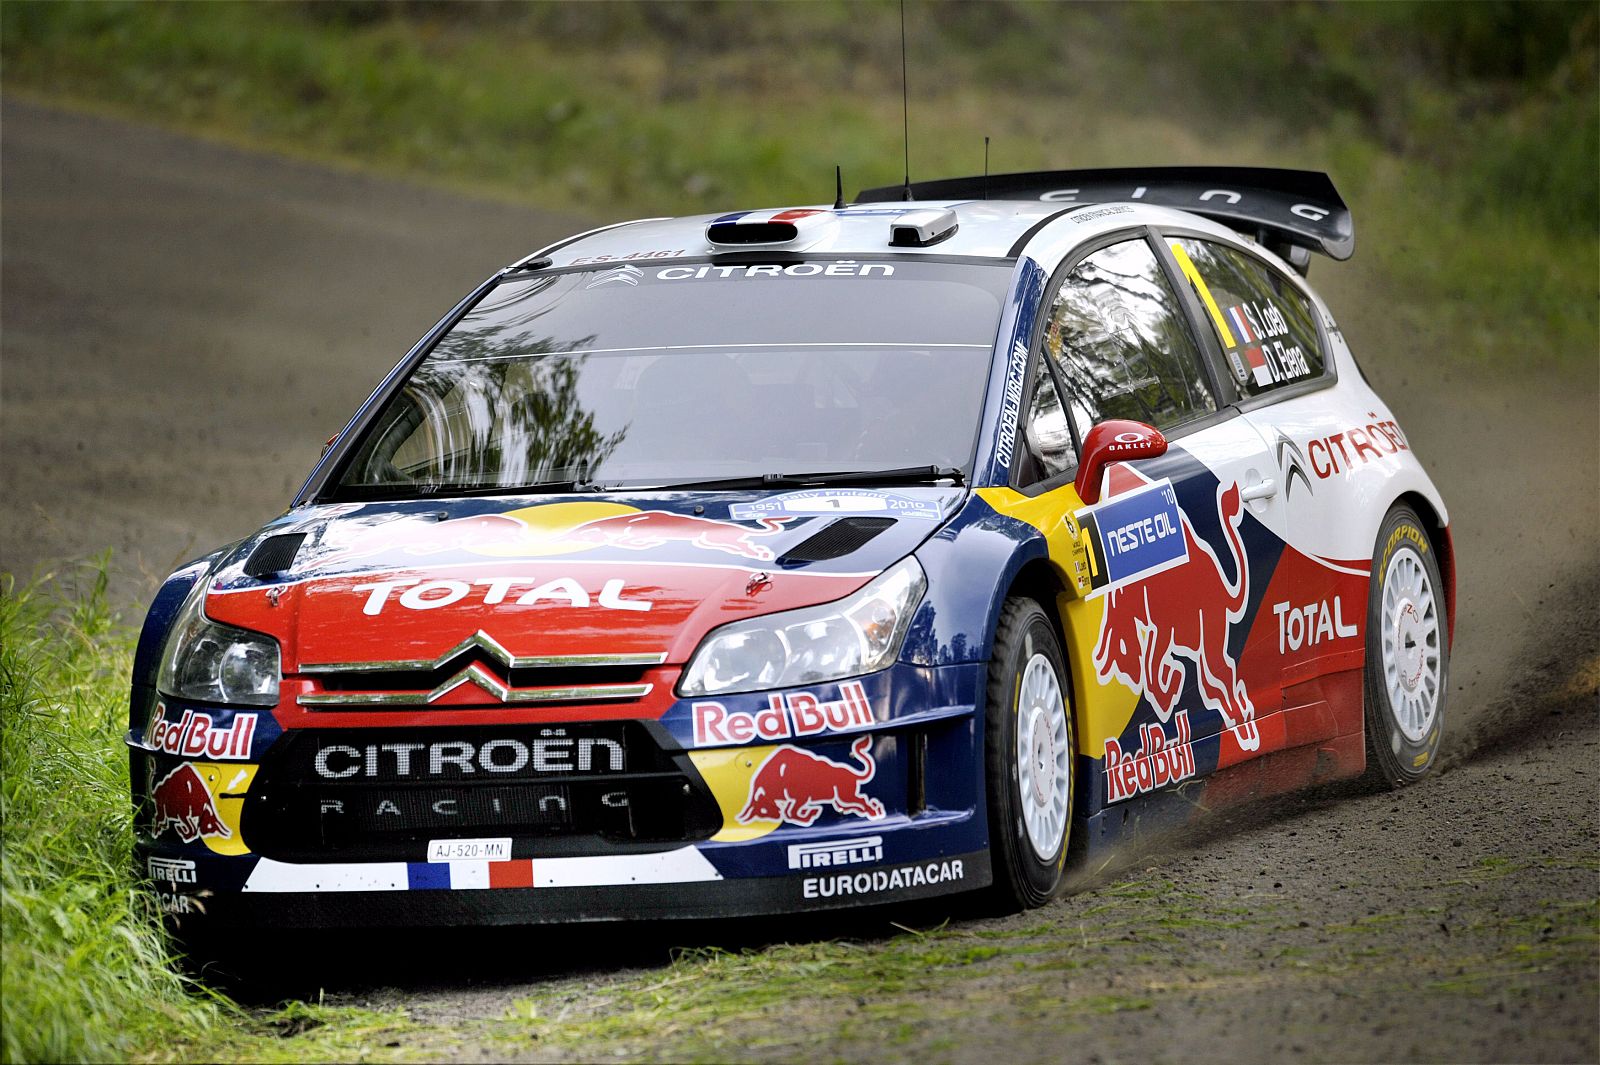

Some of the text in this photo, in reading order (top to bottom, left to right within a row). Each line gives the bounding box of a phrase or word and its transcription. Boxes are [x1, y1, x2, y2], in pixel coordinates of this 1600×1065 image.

[656, 260, 895, 280] CITROËN
[1171, 244, 1237, 349] 1
[1252, 297, 1289, 337] Loeb
[1273, 340, 1311, 379] Elena
[1108, 442, 1152, 451] OAKLEY
[750, 501, 783, 511] 1951
[776, 489, 891, 502] Rally Finland
[825, 498, 841, 509] 1
[888, 499, 925, 510] 2010
[1081, 527, 1099, 577] 1
[1107, 511, 1177, 557] NESTE OIL
[1379, 524, 1429, 590] SCORPION
[352, 576, 652, 616] TOTAL
[1273, 595, 1358, 655] TOTAL
[146, 701, 259, 760] Red Bull
[692, 680, 875, 747] Red Bull
[314, 729, 624, 778] CITROËN
[1104, 723, 1154, 804] Red
[1147, 708, 1196, 788] Bull
[320, 791, 629, 816] RACING
[147, 856, 197, 883] PIRELLI
[435, 844, 504, 858] AJ-520-MN
[788, 836, 884, 869] PIRELLI
[803, 860, 964, 898] EURODATACAR
